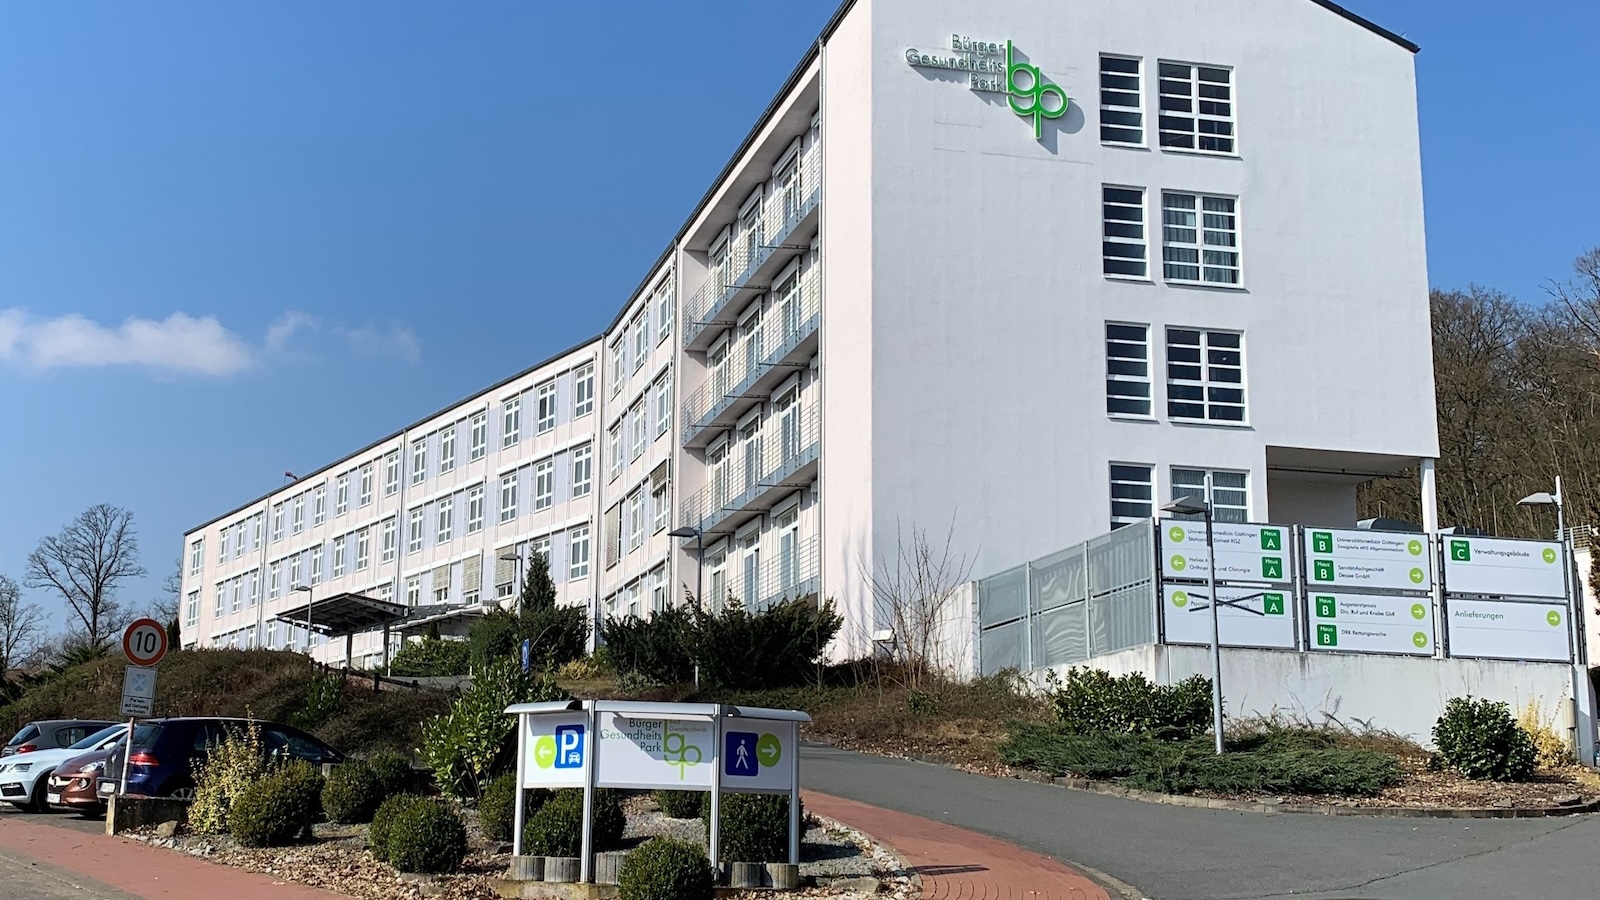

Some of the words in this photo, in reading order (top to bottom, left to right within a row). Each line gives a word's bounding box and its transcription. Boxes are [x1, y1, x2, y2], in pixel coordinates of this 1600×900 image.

[952, 34, 1003, 57] Bürger
[905, 48, 1004, 73] Gesundheits
[969, 72, 1004, 92] Park
[1235, 531, 1258, 539] Göttingen
[1266, 538, 1276, 548] A
[1319, 541, 1327, 551] B
[1456, 549, 1466, 559] C
[1474, 548, 1530, 557] Verwaltungsgebäude
[1267, 566, 1277, 576] A
[1320, 568, 1328, 579] B
[1269, 602, 1279, 612] A
[1322, 605, 1330, 615] B
[1455, 610, 1504, 620] Anlieferungen
[135, 630, 157, 654] 10
[1323, 633, 1331, 644] B
[629, 717, 663, 731] Bürger
[600, 729, 662, 740] Gesundheits
[640, 741, 662, 752] Park
